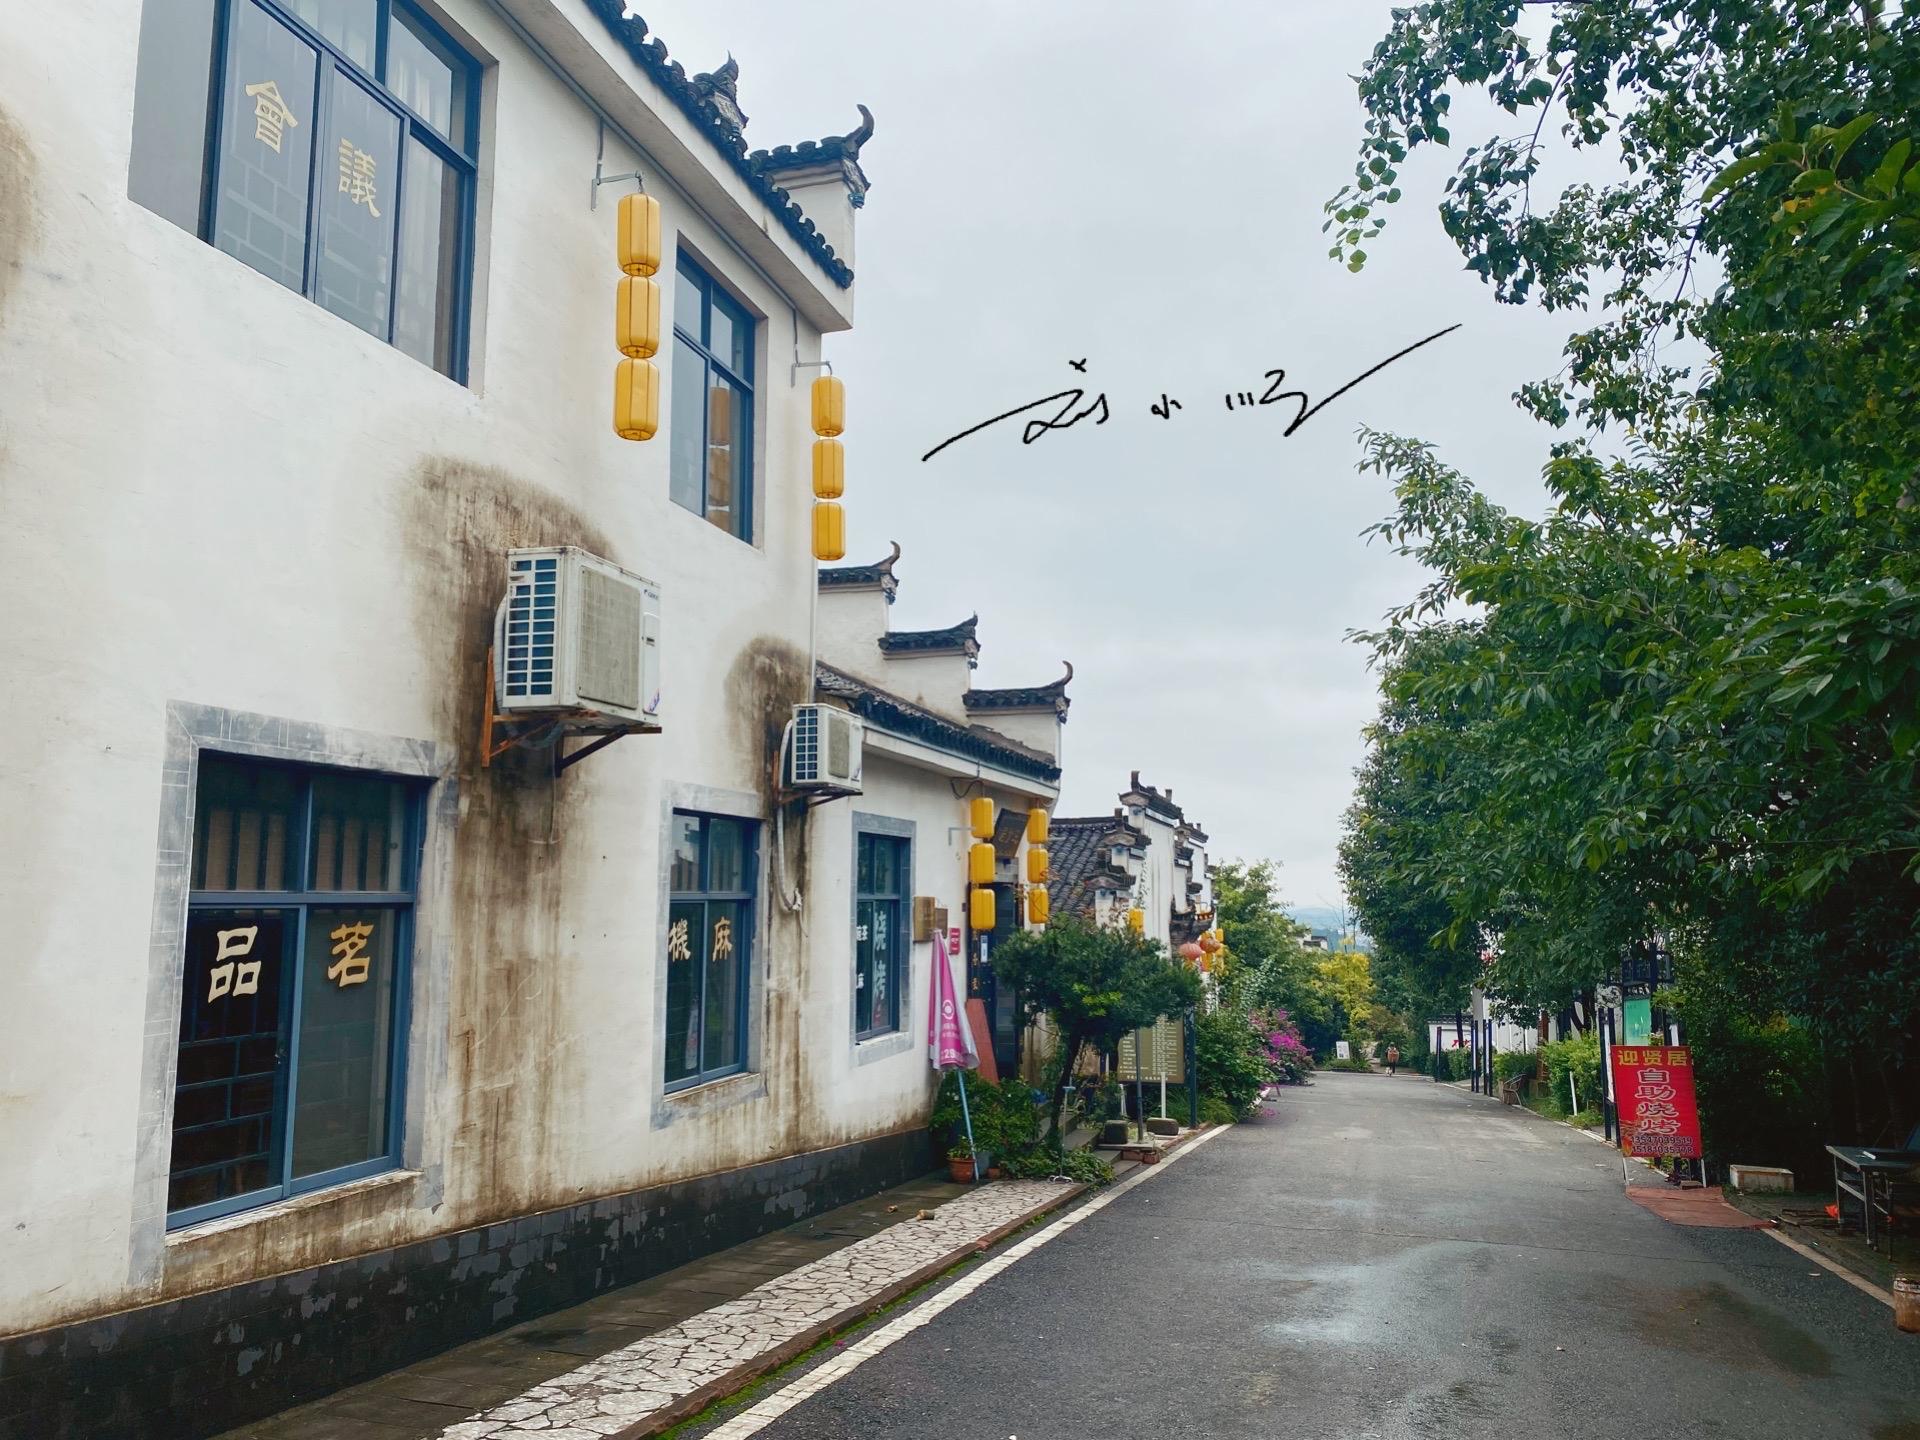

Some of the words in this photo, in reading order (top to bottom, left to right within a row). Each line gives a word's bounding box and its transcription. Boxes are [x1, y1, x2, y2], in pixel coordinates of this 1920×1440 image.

[245, 80, 381, 218] 會議
[207, 920, 375, 1003] 品茗
[1617, 1049, 1688, 1066] 迎贤居
[1635, 1067, 1682, 1135] 自助烧烤
